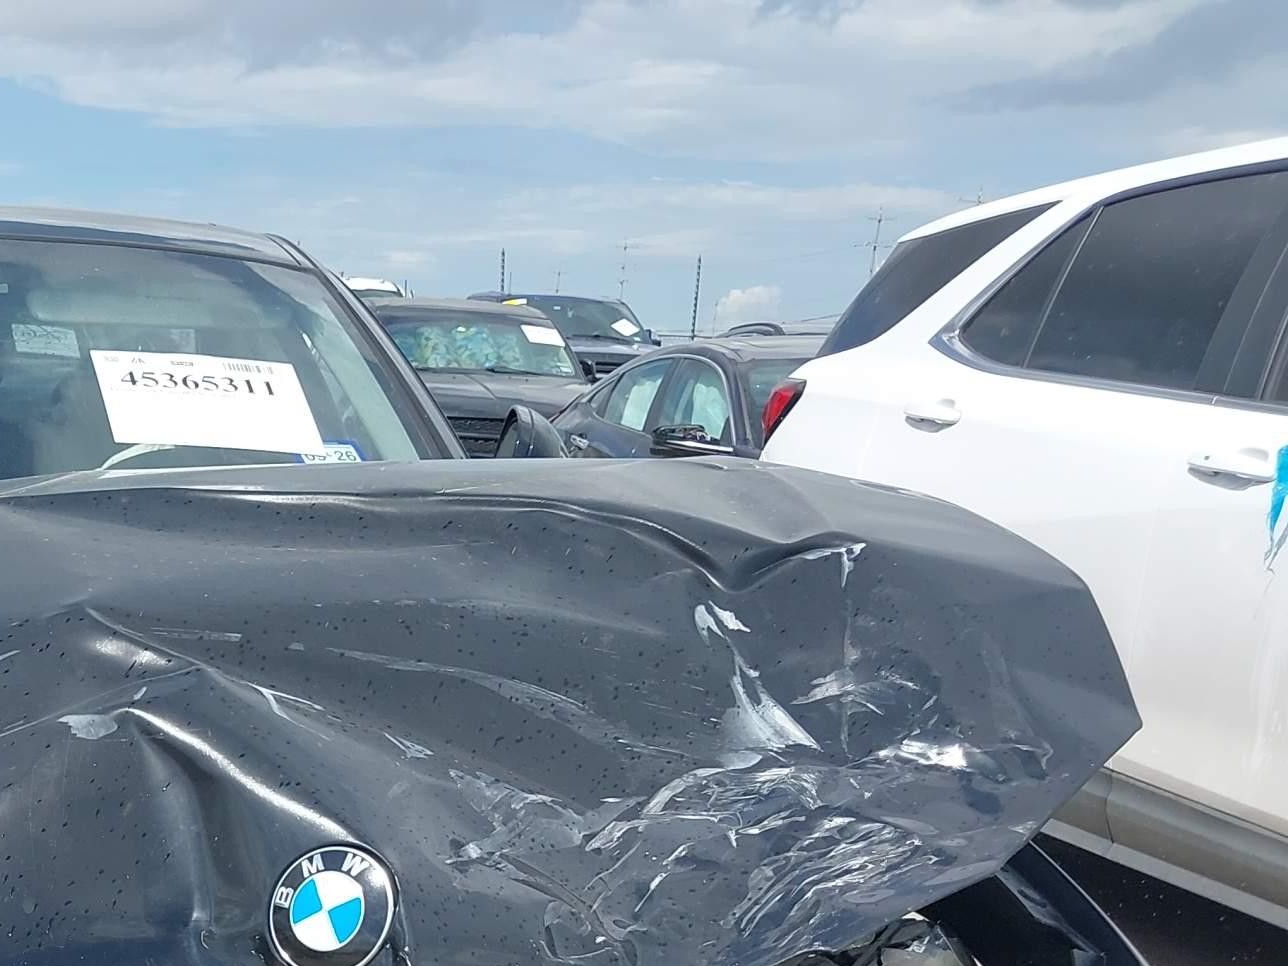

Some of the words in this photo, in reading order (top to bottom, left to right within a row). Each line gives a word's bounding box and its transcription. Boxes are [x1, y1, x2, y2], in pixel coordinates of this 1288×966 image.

[121, 370, 274, 396] 45365311
[334, 450, 357, 462] 26
[274, 852, 369, 909] BMW
